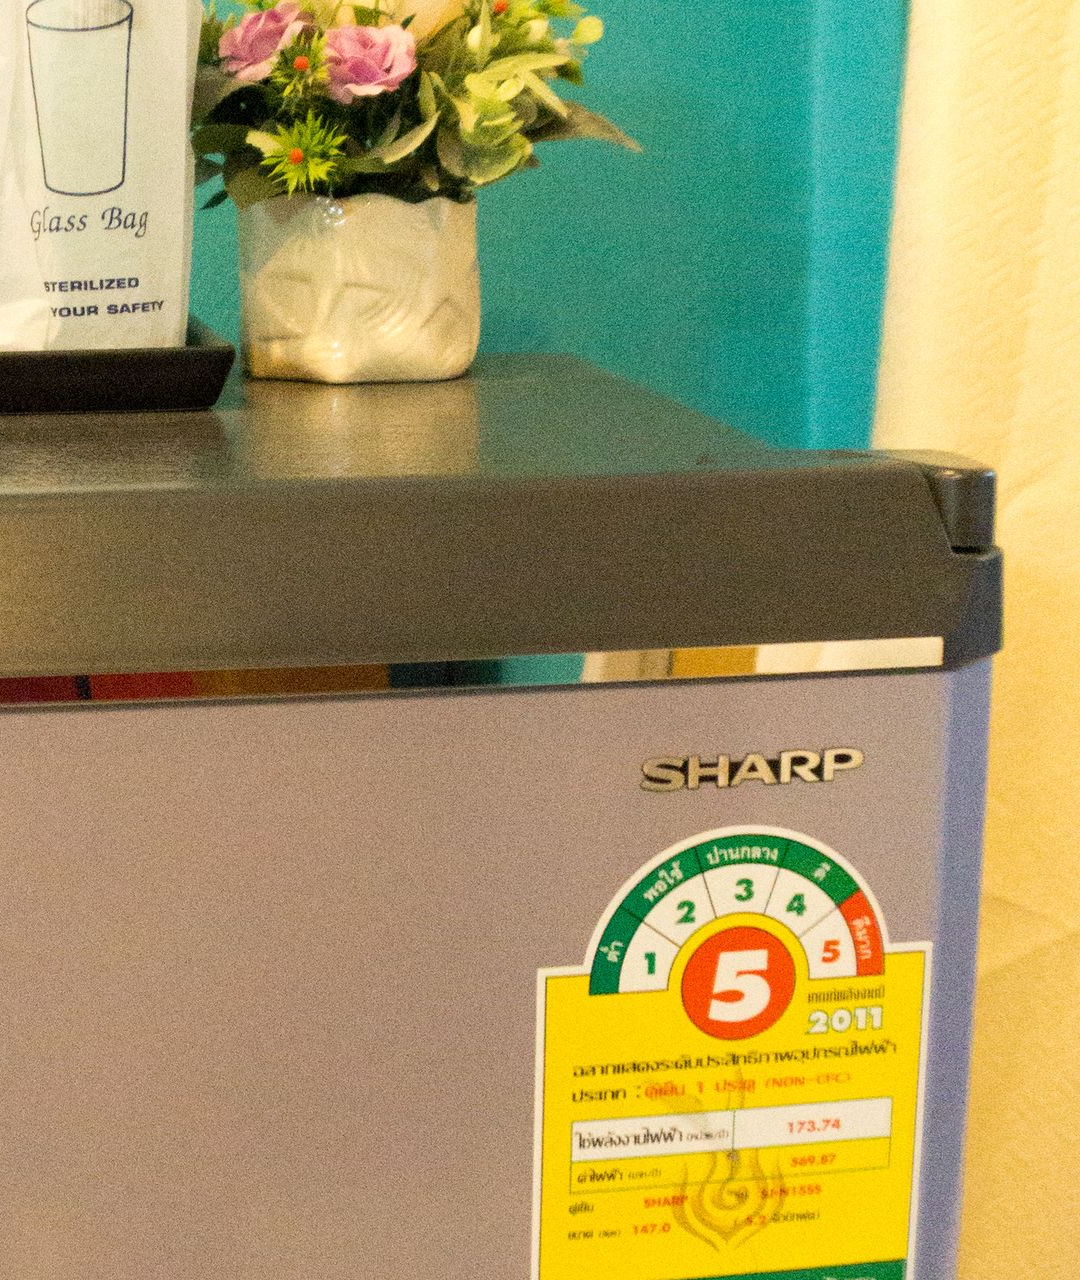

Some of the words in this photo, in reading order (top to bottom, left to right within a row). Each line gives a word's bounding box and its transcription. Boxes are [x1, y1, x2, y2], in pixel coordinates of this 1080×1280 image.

[30, 206, 88, 241] Glass
[101, 206, 149, 238] Bag
[43, 277, 139, 293] STERILIZED
[51, 305, 99, 318] YOUR
[106, 300, 164, 315] SAFETY
[639, 747, 865, 793] SHARP
[706, 845, 779, 866] ปานกลาง
[644, 951, 656, 975] 1
[676, 900, 696, 924] 2
[734, 878, 754, 901] 3
[786, 893, 807, 916] 4
[821, 939, 841, 963] 5
[707, 948, 771, 1024] 5
[806, 1005, 883, 1035] 2011
[787, 1118, 842, 1134] 173.74
[643, 1194, 688, 1209] SHARP
